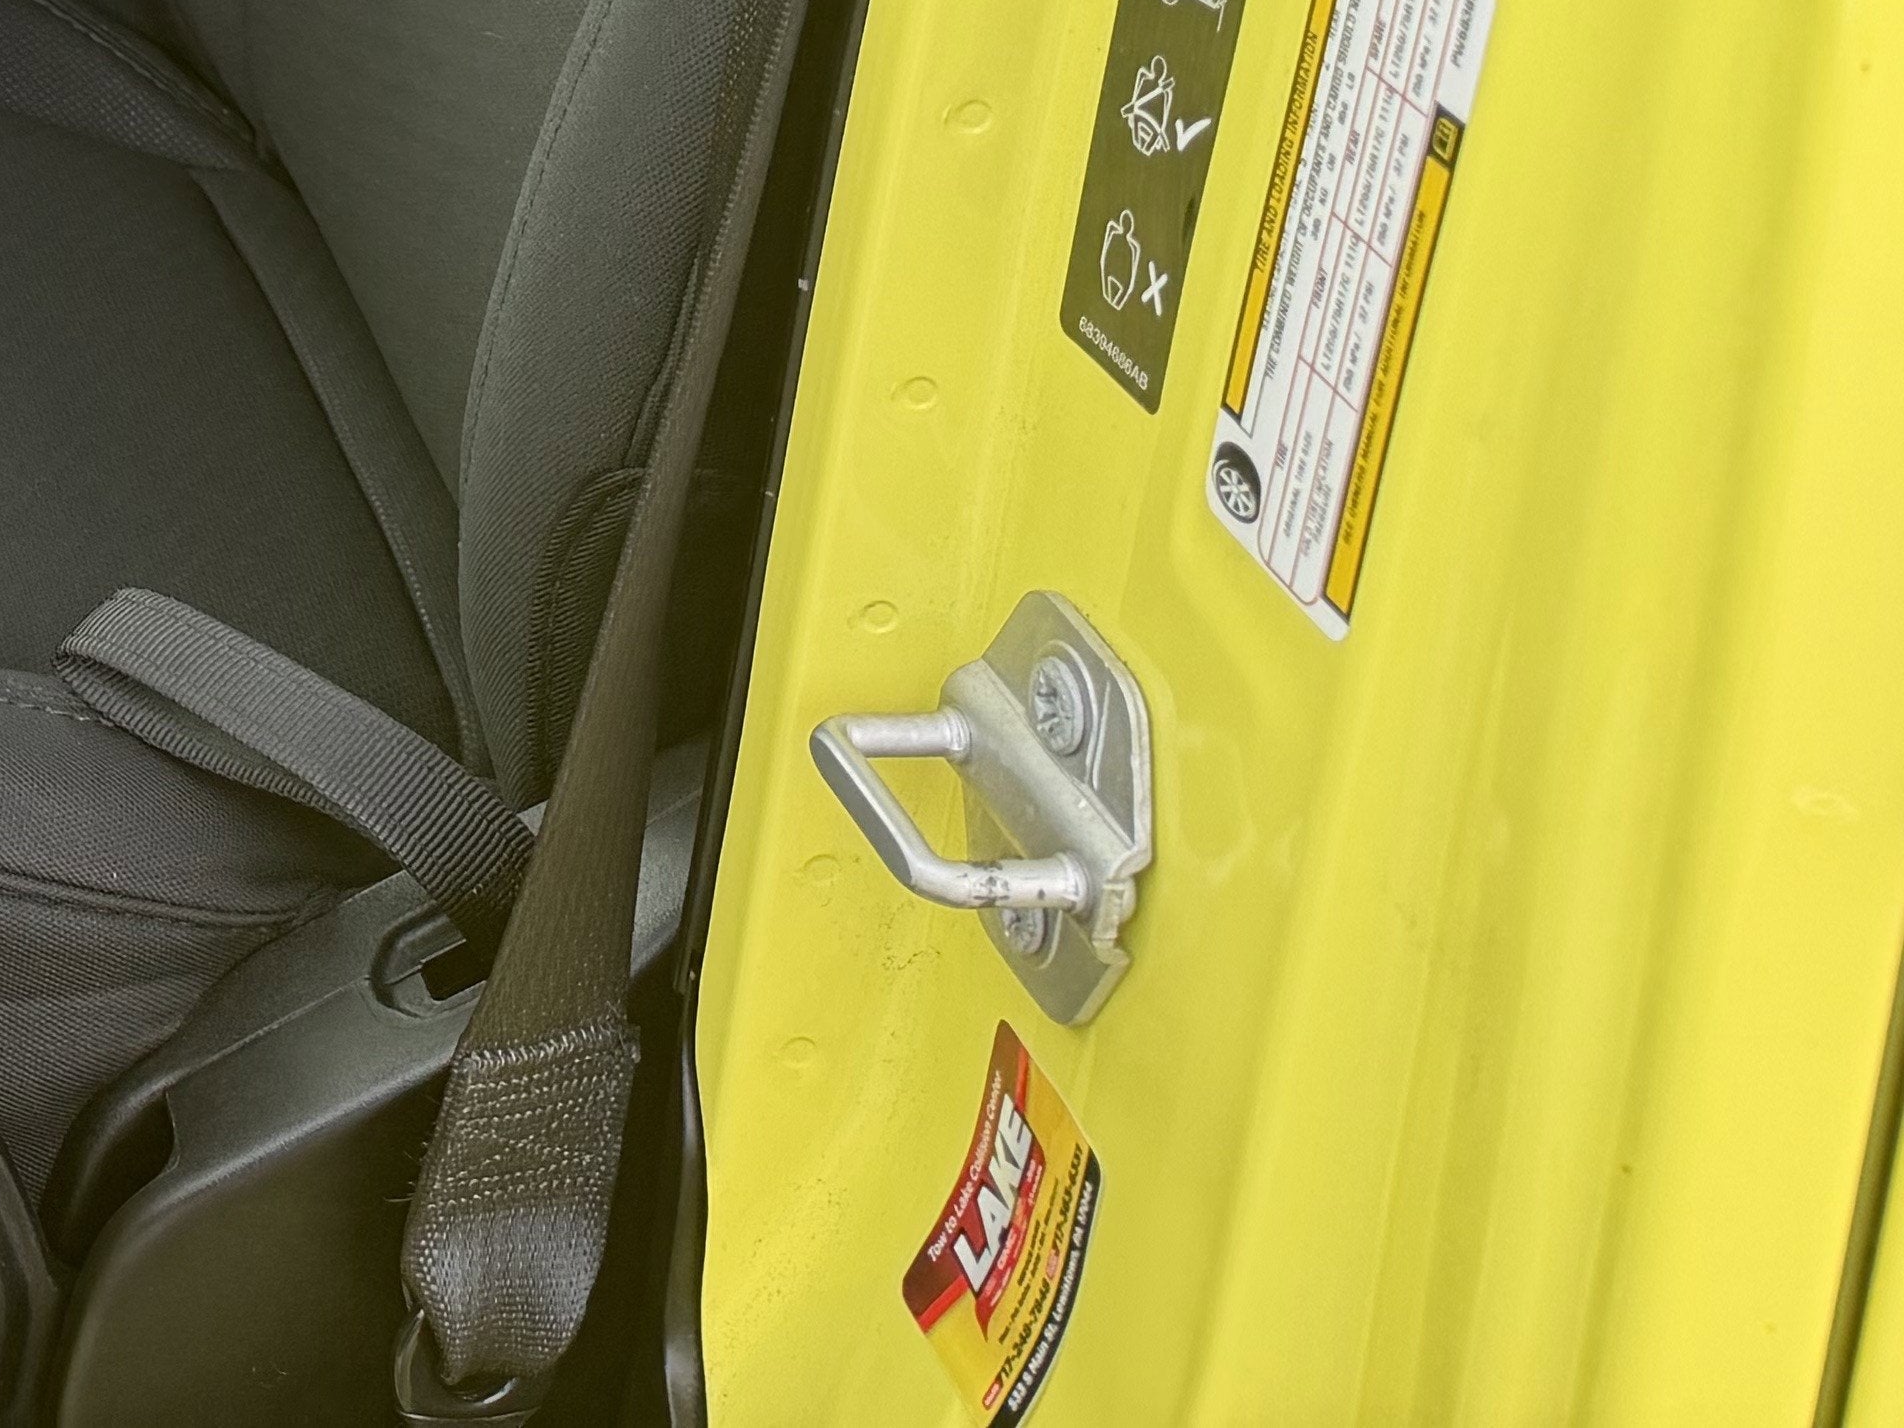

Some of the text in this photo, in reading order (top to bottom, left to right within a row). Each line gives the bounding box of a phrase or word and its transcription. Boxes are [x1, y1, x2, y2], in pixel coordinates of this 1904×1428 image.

[927, 1233, 948, 1262] Tow
[944, 1215, 958, 1233] to
[953, 1180, 974, 1217] Lake
[969, 1120, 993, 1182] Collision
[953, 1093, 1033, 1292] LAKE
[1028, 1341, 1049, 1376] Main
